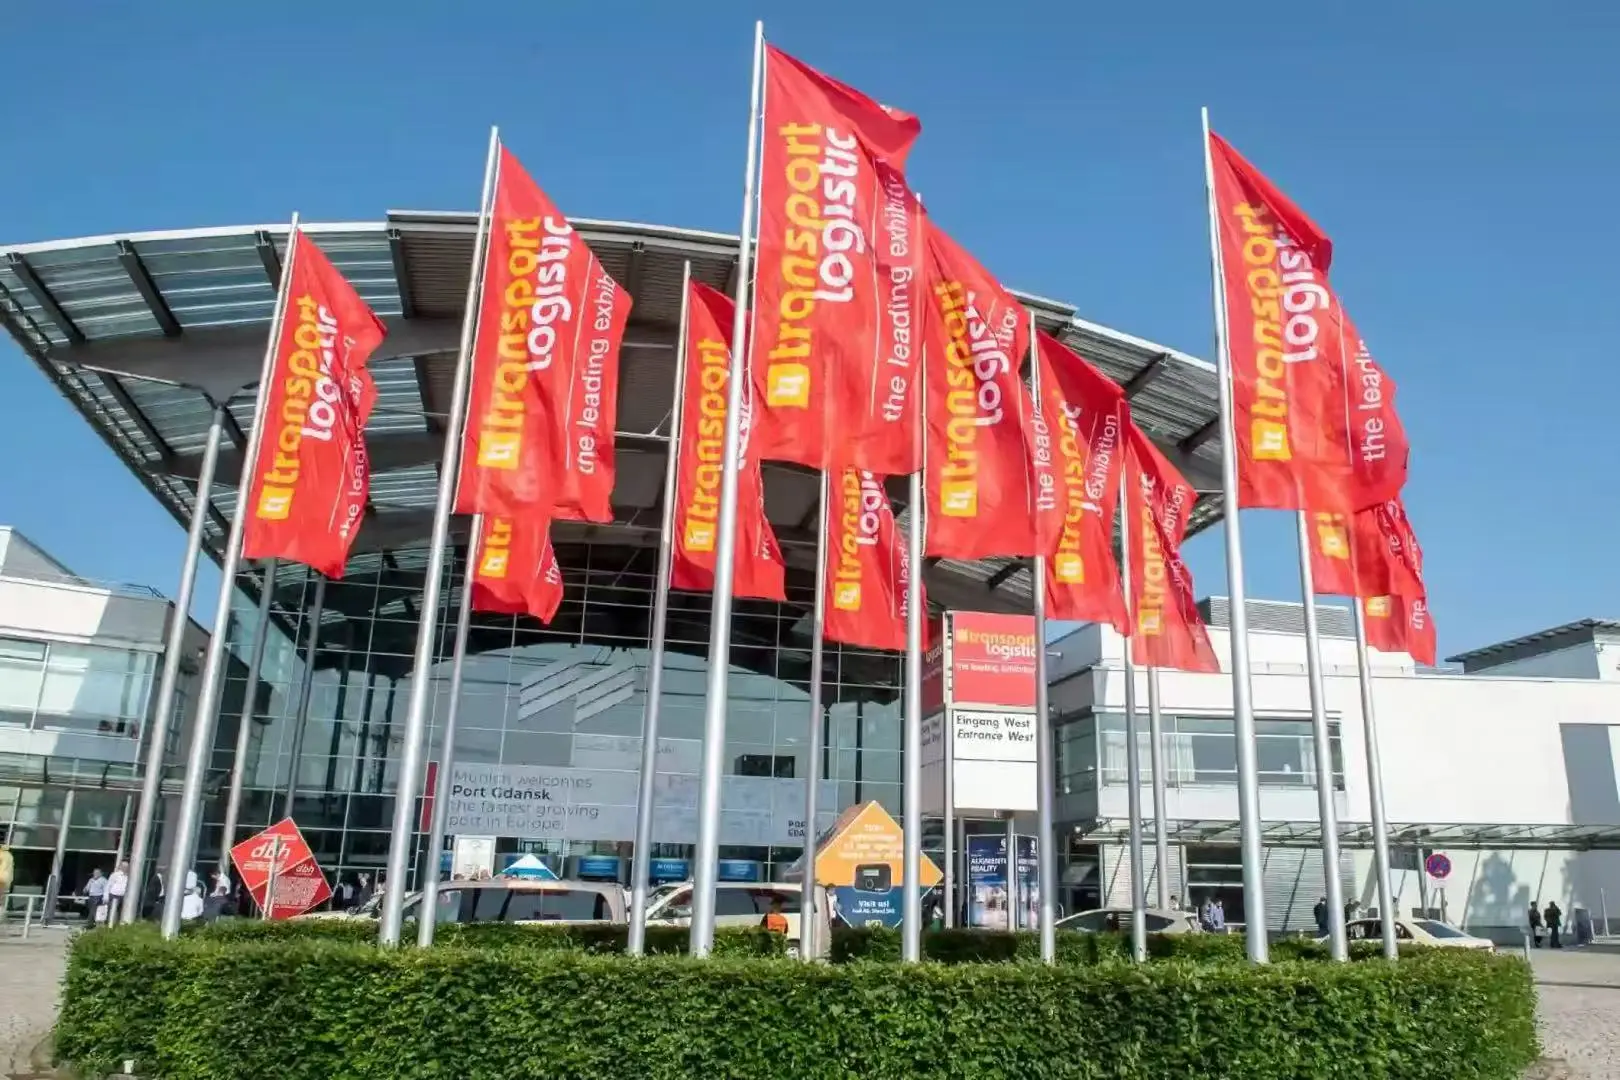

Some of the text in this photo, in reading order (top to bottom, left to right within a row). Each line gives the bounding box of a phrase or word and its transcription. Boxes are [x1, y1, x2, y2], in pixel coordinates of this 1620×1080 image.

[814, 127, 865, 303] logistic
[768, 122, 826, 359] transport
[526, 216, 573, 372] logistic
[887, 266, 912, 367] leading
[1233, 203, 1289, 417] transport
[481, 216, 541, 428] transport
[263, 294, 325, 484] transport
[576, 338, 609, 428] leading
[883, 376, 906, 421] the
[1360, 417, 1385, 462] the
[1036, 472, 1055, 512] the
[956, 715, 1030, 728] Eingang West
[957, 729, 1034, 742] Entrance West
[452, 784, 486, 796] Port
[454, 770, 593, 788] Munich welcomes
[449, 815, 482, 827] port
[487, 817, 500, 828] in
[450, 799, 599, 819] the fastest growing
